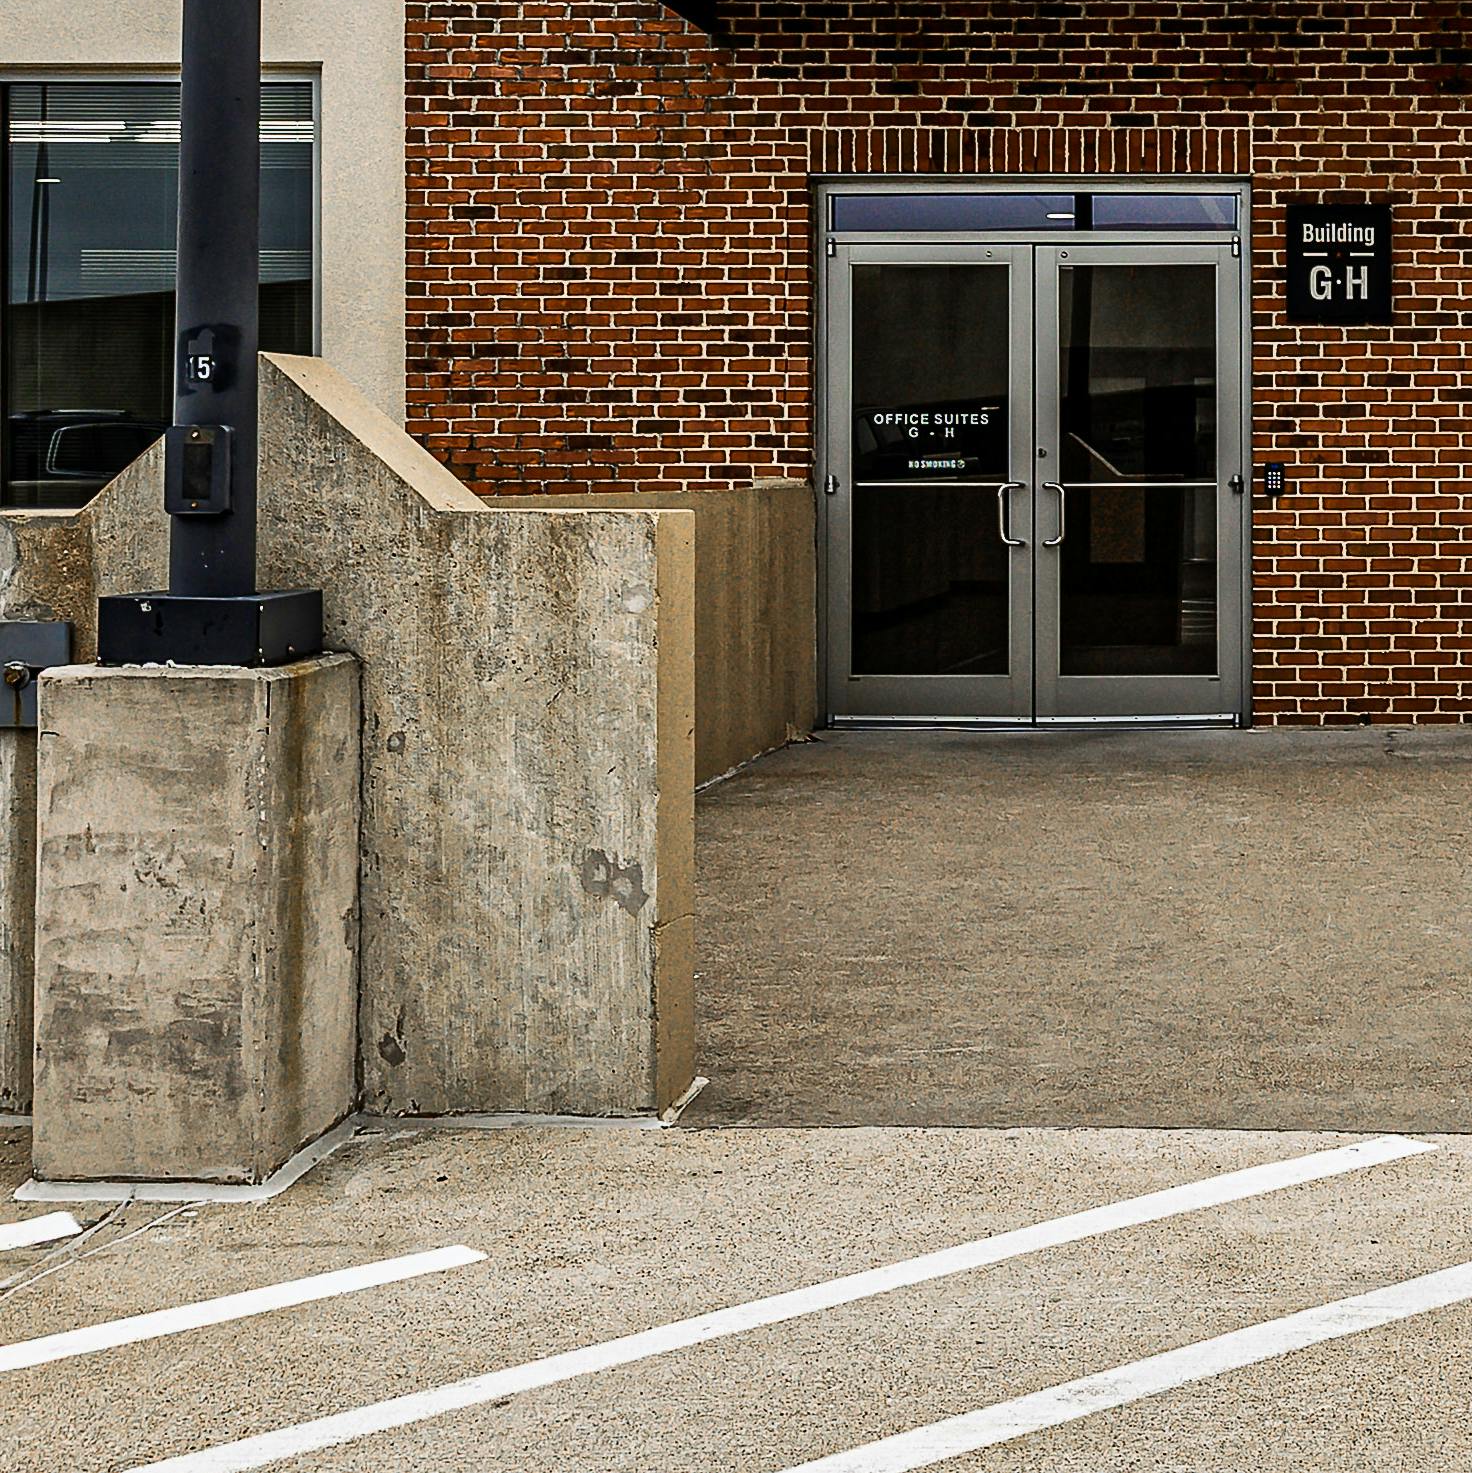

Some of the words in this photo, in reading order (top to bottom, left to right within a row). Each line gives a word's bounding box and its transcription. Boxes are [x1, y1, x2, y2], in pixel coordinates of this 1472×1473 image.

[1302, 222, 1375, 247] Building
[873, 413, 930, 425] OFFICE
[934, 413, 989, 425] SUITES
